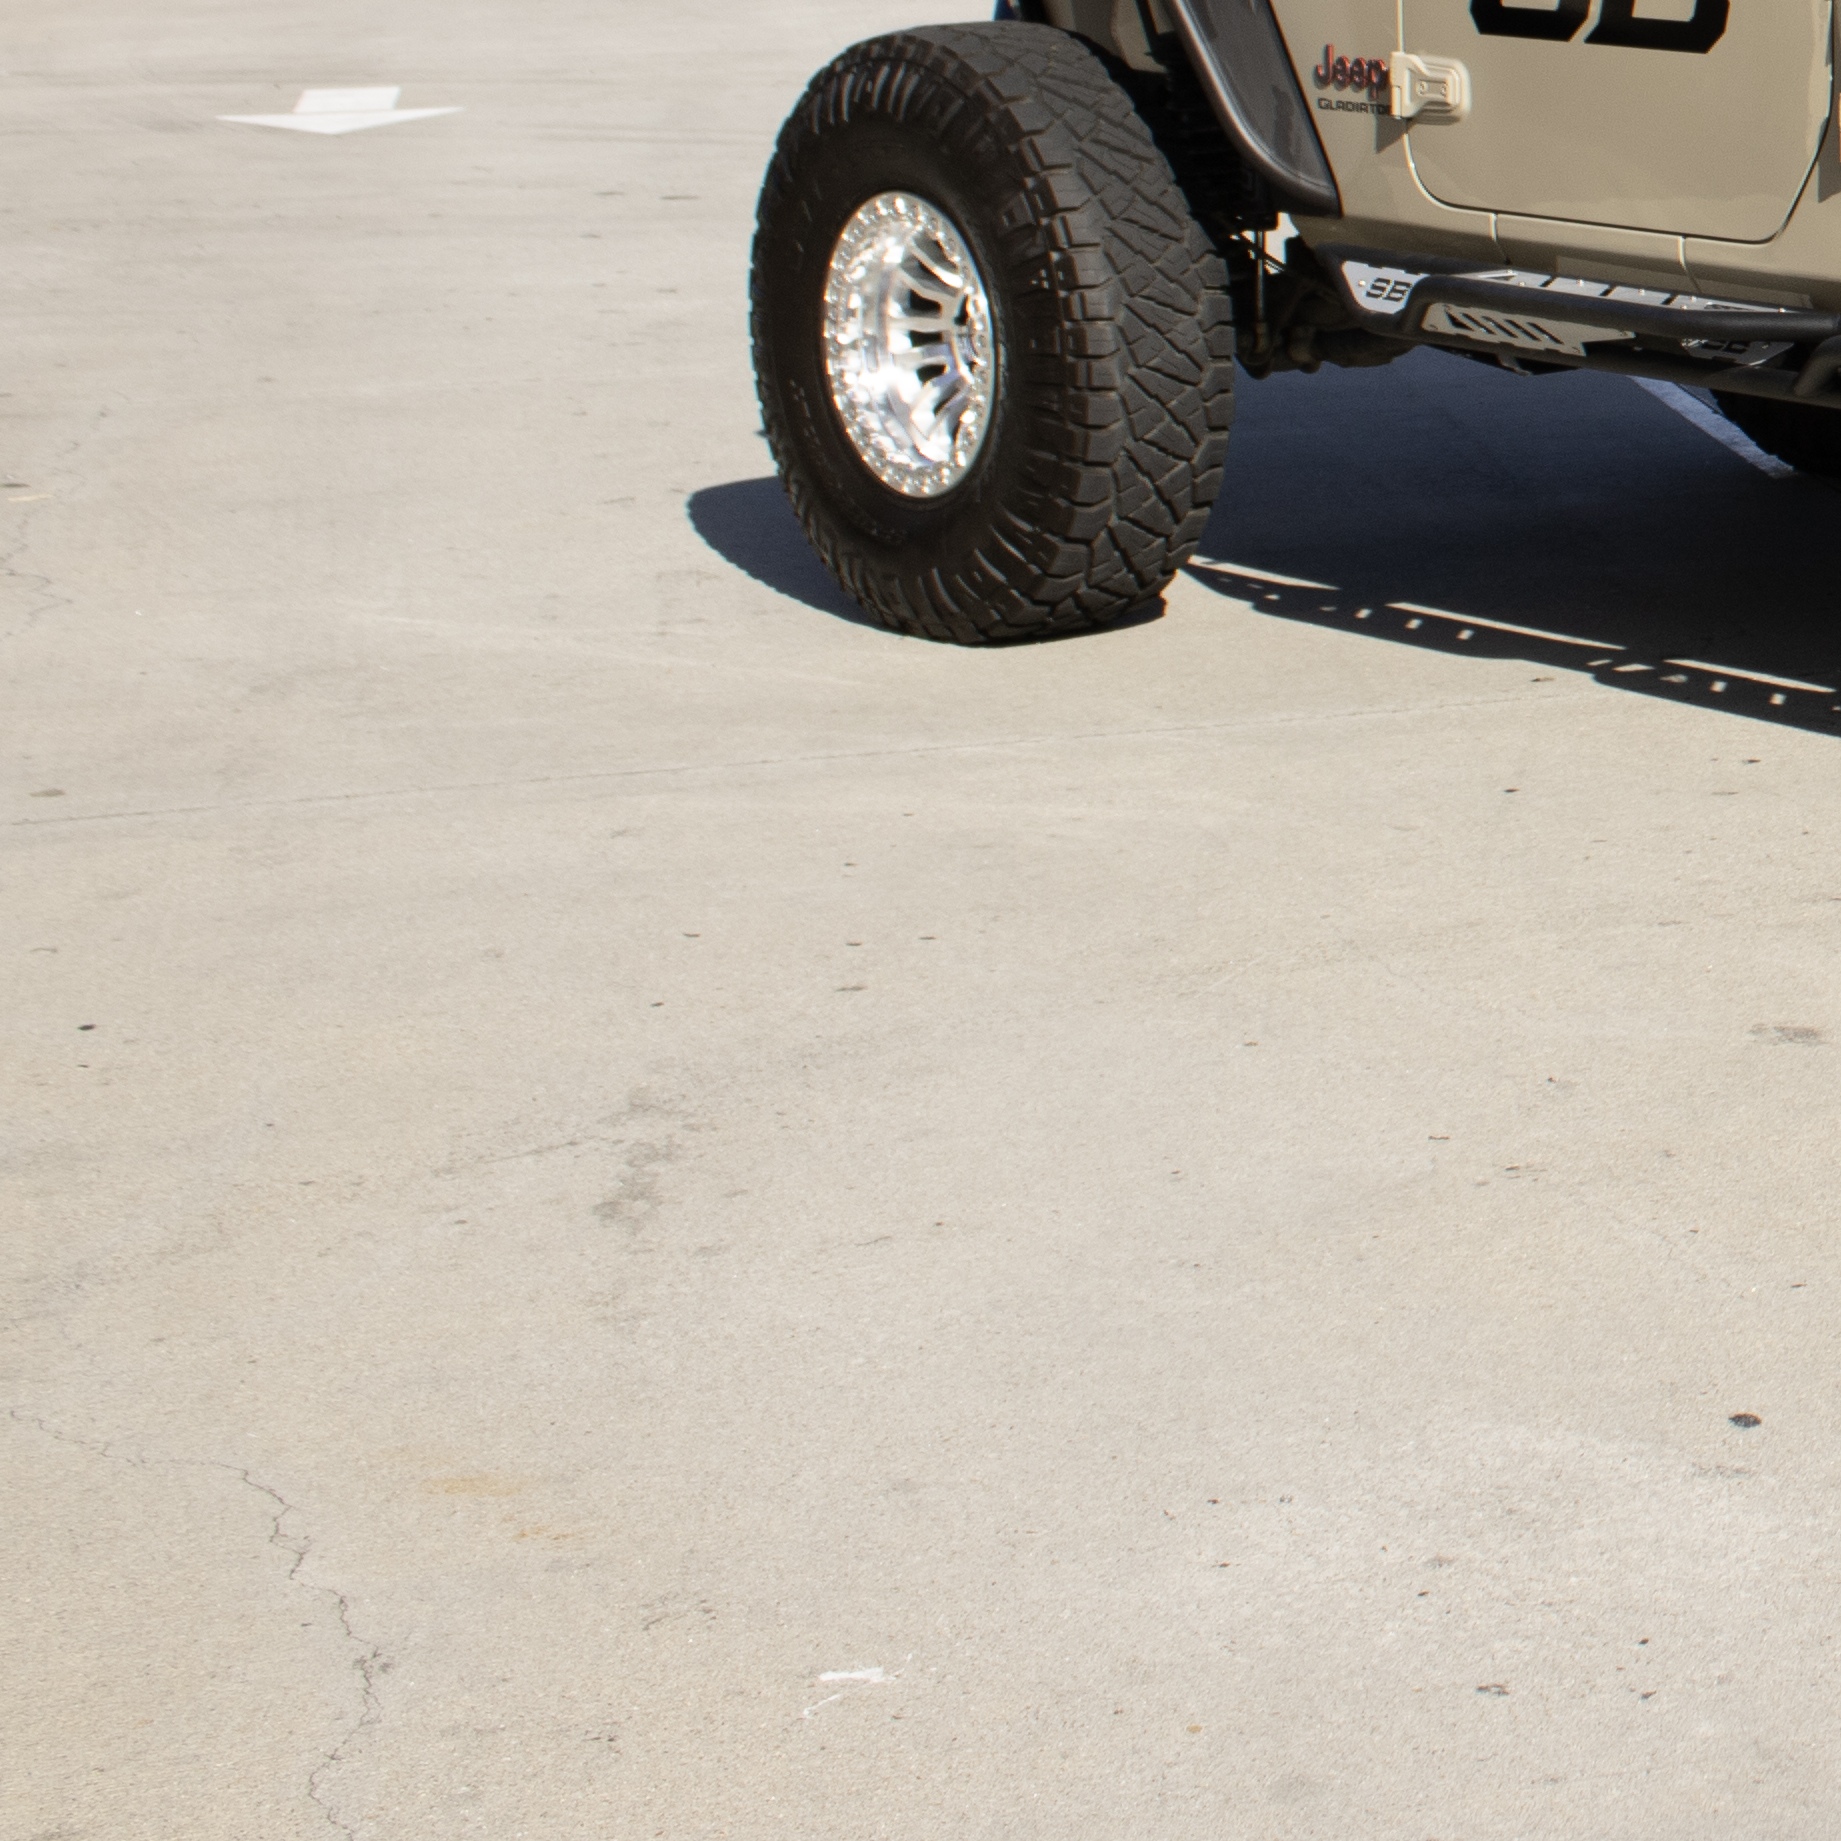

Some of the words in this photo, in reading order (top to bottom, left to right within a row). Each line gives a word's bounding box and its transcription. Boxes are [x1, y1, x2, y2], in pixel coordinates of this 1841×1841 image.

[1313, 43, 1389, 102] Jeep
[1316, 97, 1391, 116] GLADIATO
[1365, 276, 1413, 303] SB
